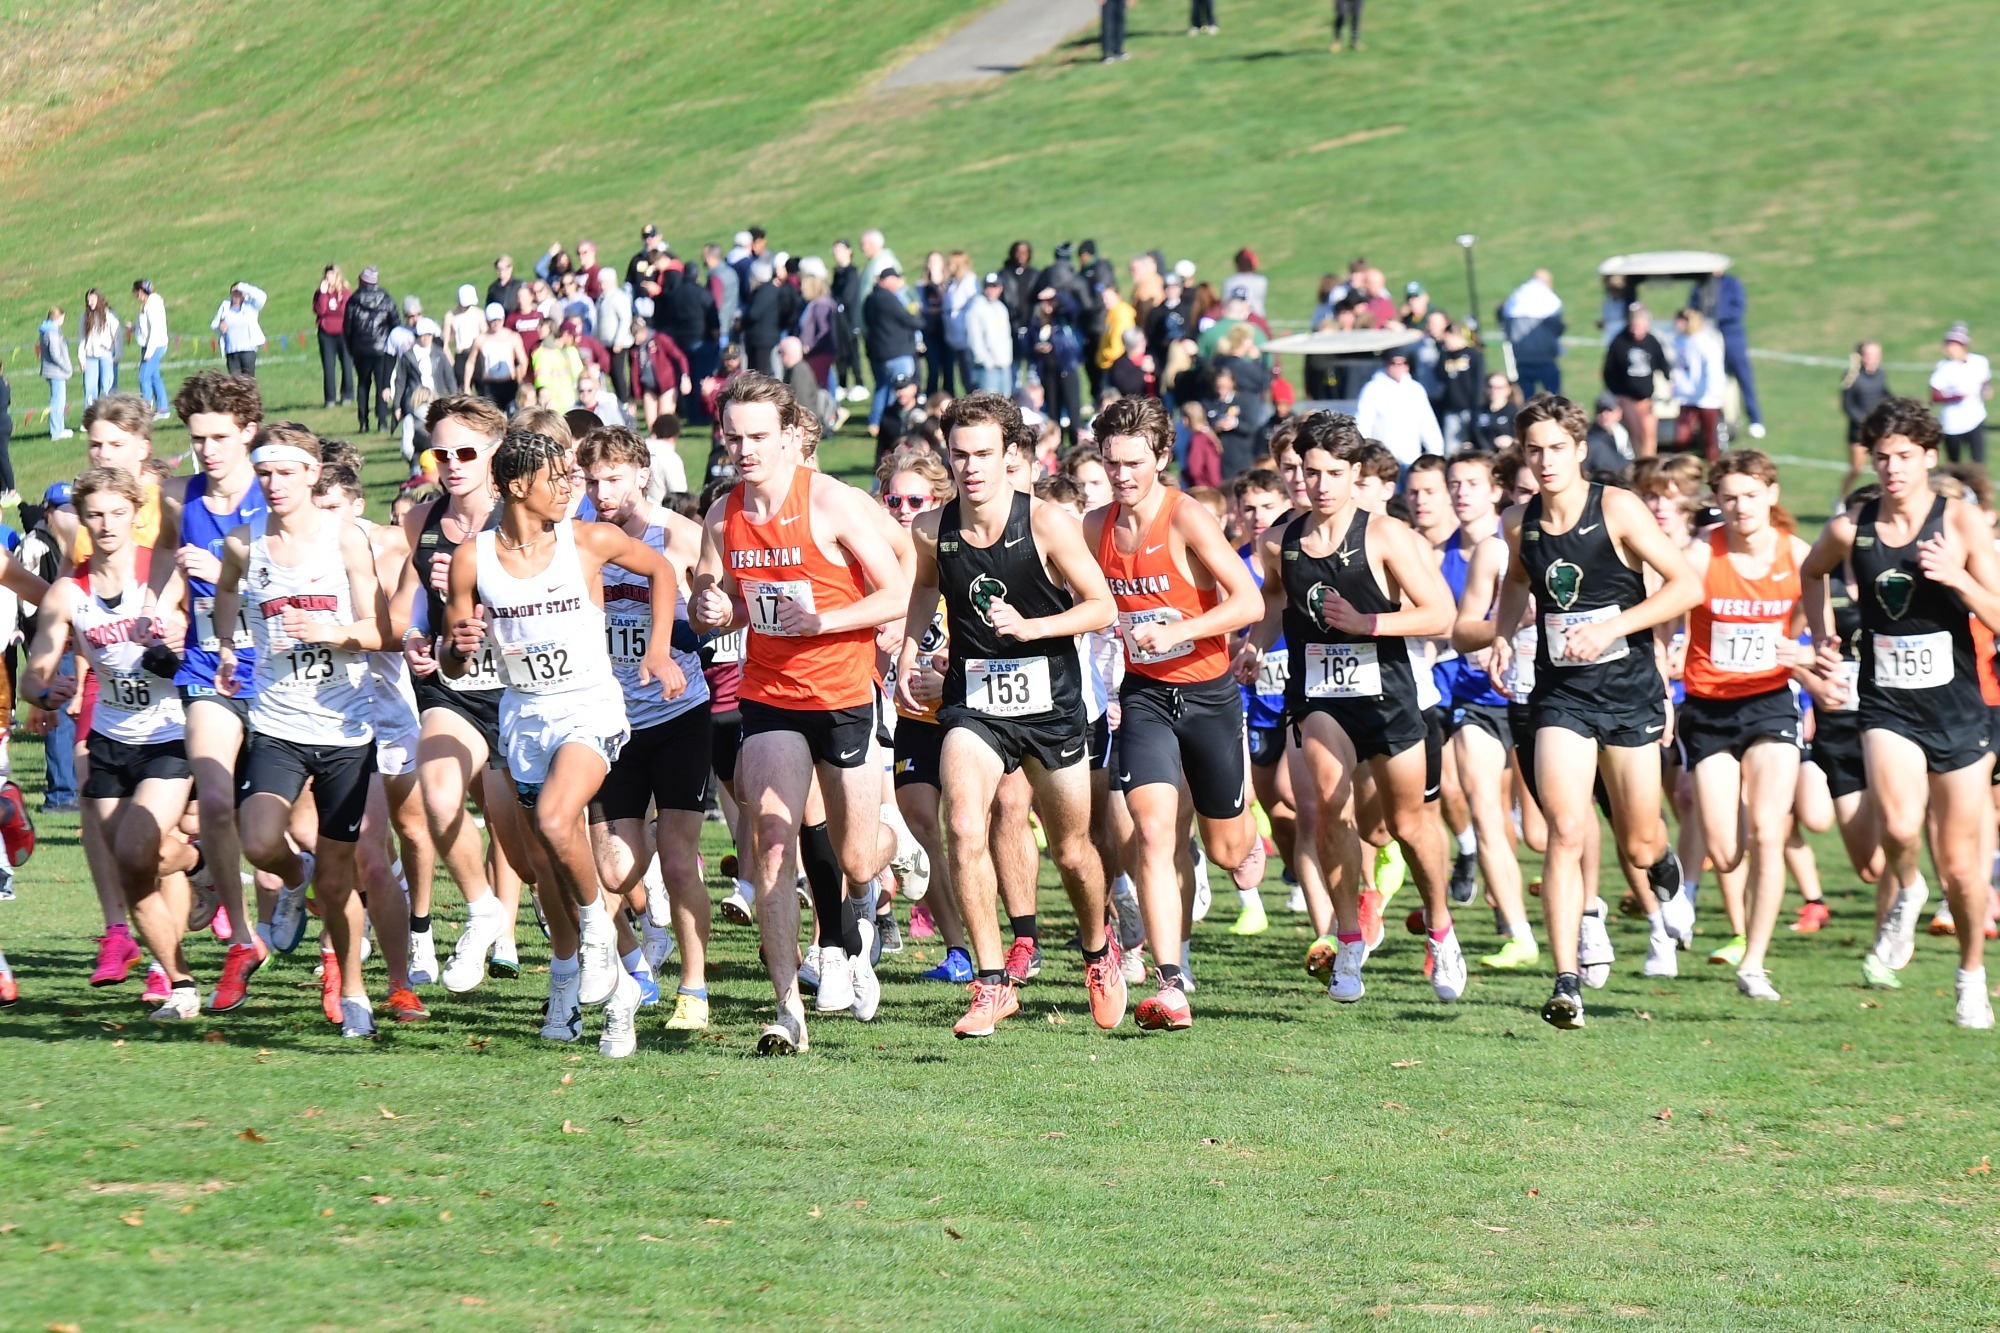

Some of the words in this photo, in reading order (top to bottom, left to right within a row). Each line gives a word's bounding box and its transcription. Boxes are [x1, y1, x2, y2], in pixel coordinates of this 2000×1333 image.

[730, 545, 803, 570] WESLEYAN
[621, 583, 650, 605] ELKIN
[759, 586, 784, 595] EAST
[487, 602, 542, 619] AIRMONT
[546, 597, 580, 614] STATE
[755, 594, 794, 625] 17
[1131, 613, 1157, 625] EAST
[1710, 598, 1793, 617] WESLEYAN
[611, 618, 638, 627] EAST
[525, 642, 556, 654] EAST
[605, 626, 647, 657] 115
[1325, 648, 1351, 656] EAST
[1726, 636, 1765, 662] 179
[286, 648, 334, 681] 123
[468, 648, 498, 678] 64
[521, 648, 573, 681] 132
[989, 664, 1020, 673] EAST
[1261, 662, 1287, 685] 14
[1320, 656, 1361, 686] 162
[1888, 648, 1933, 676] 159
[109, 679, 151, 706] 136
[982, 672, 1030, 704] 153
